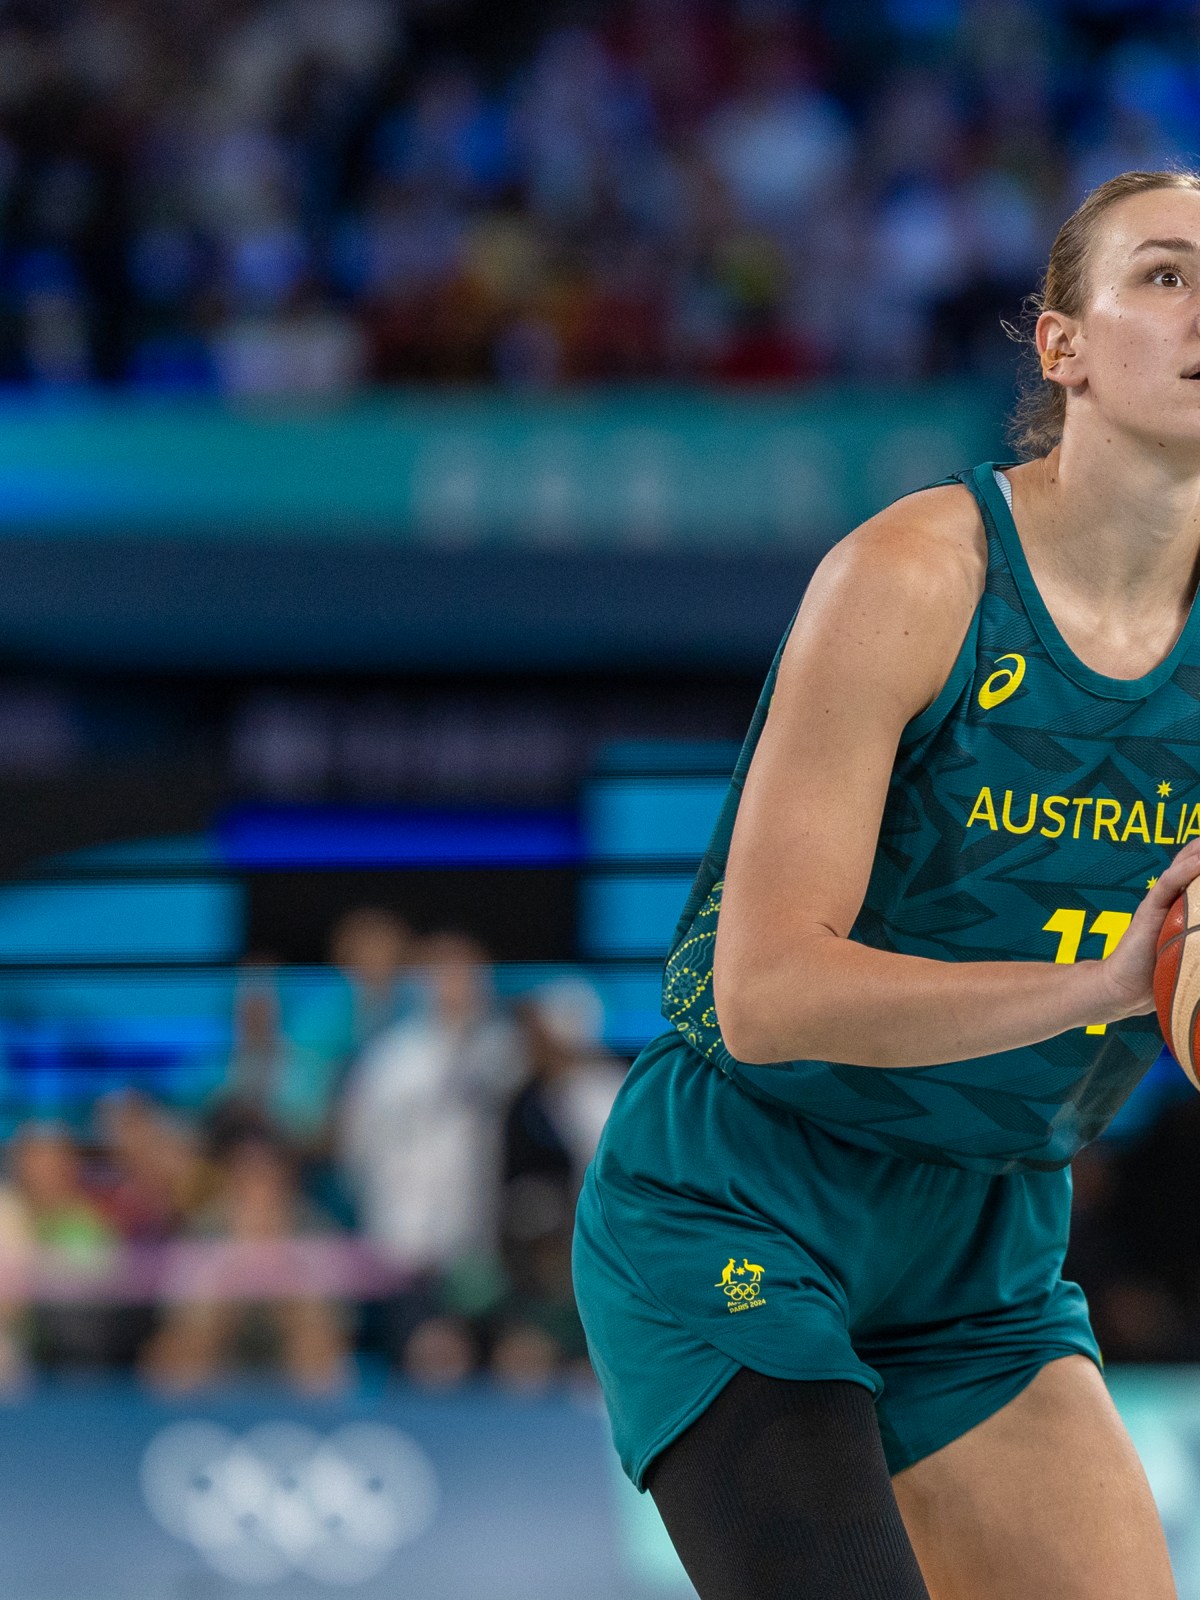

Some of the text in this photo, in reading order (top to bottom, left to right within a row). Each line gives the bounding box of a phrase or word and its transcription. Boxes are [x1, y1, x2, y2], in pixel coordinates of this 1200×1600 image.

[1042, 908, 1133, 1035] 11
[729, 1303, 749, 1314] PARIS
[750, 1298, 767, 1308] 2024
